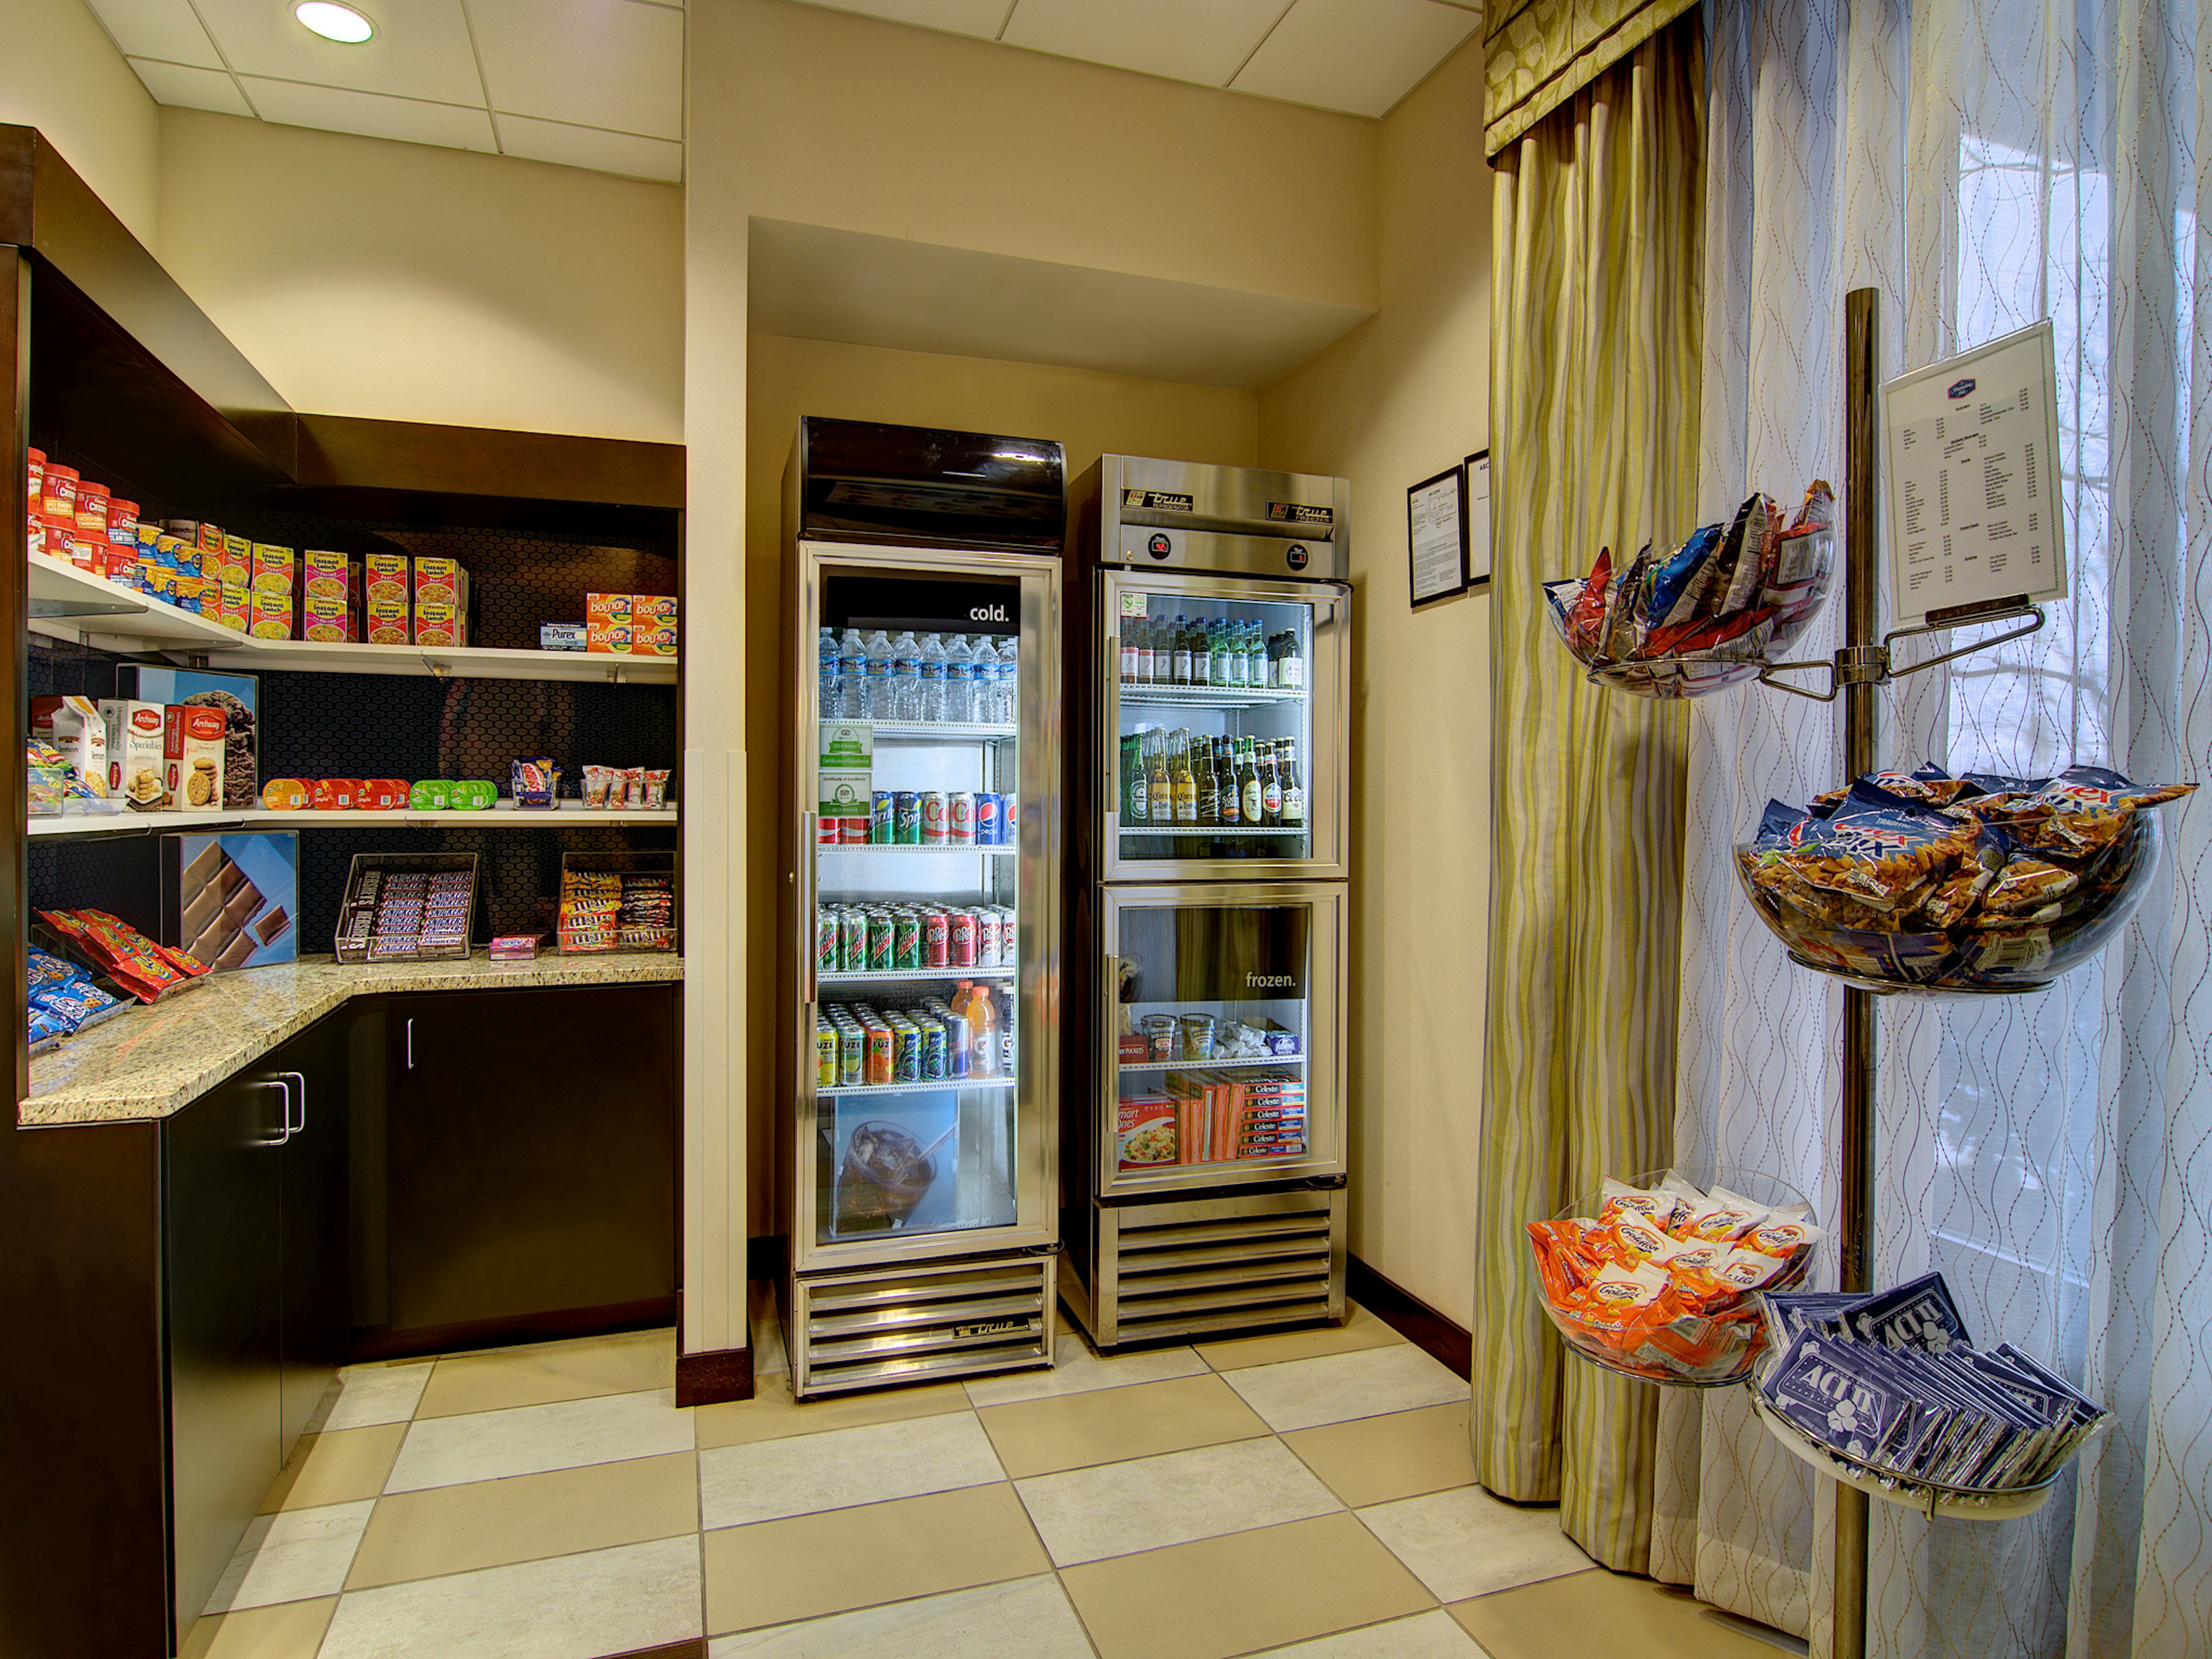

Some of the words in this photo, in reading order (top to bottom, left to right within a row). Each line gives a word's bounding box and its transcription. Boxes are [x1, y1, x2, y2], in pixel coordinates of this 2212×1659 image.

[591, 600, 624, 613] bounce
[637, 603, 669, 615] bounce
[970, 604, 1009, 622] cold.
[552, 628, 576, 639] Purex
[591, 630, 624, 642] bounce
[637, 632, 669, 644] bounce
[135, 713, 160, 726] Archway
[193, 718, 220, 730] Archway
[130, 739, 162, 750] Specialties
[426, 918, 465, 926] SNICKERS
[1246, 971, 1296, 987] frozen.
[1119, 1109, 1139, 1119] mart
[1884, 1309, 1923, 1353] ACT
[1798, 1364, 1852, 1402] ACT
[1852, 1385, 1875, 1416] II
